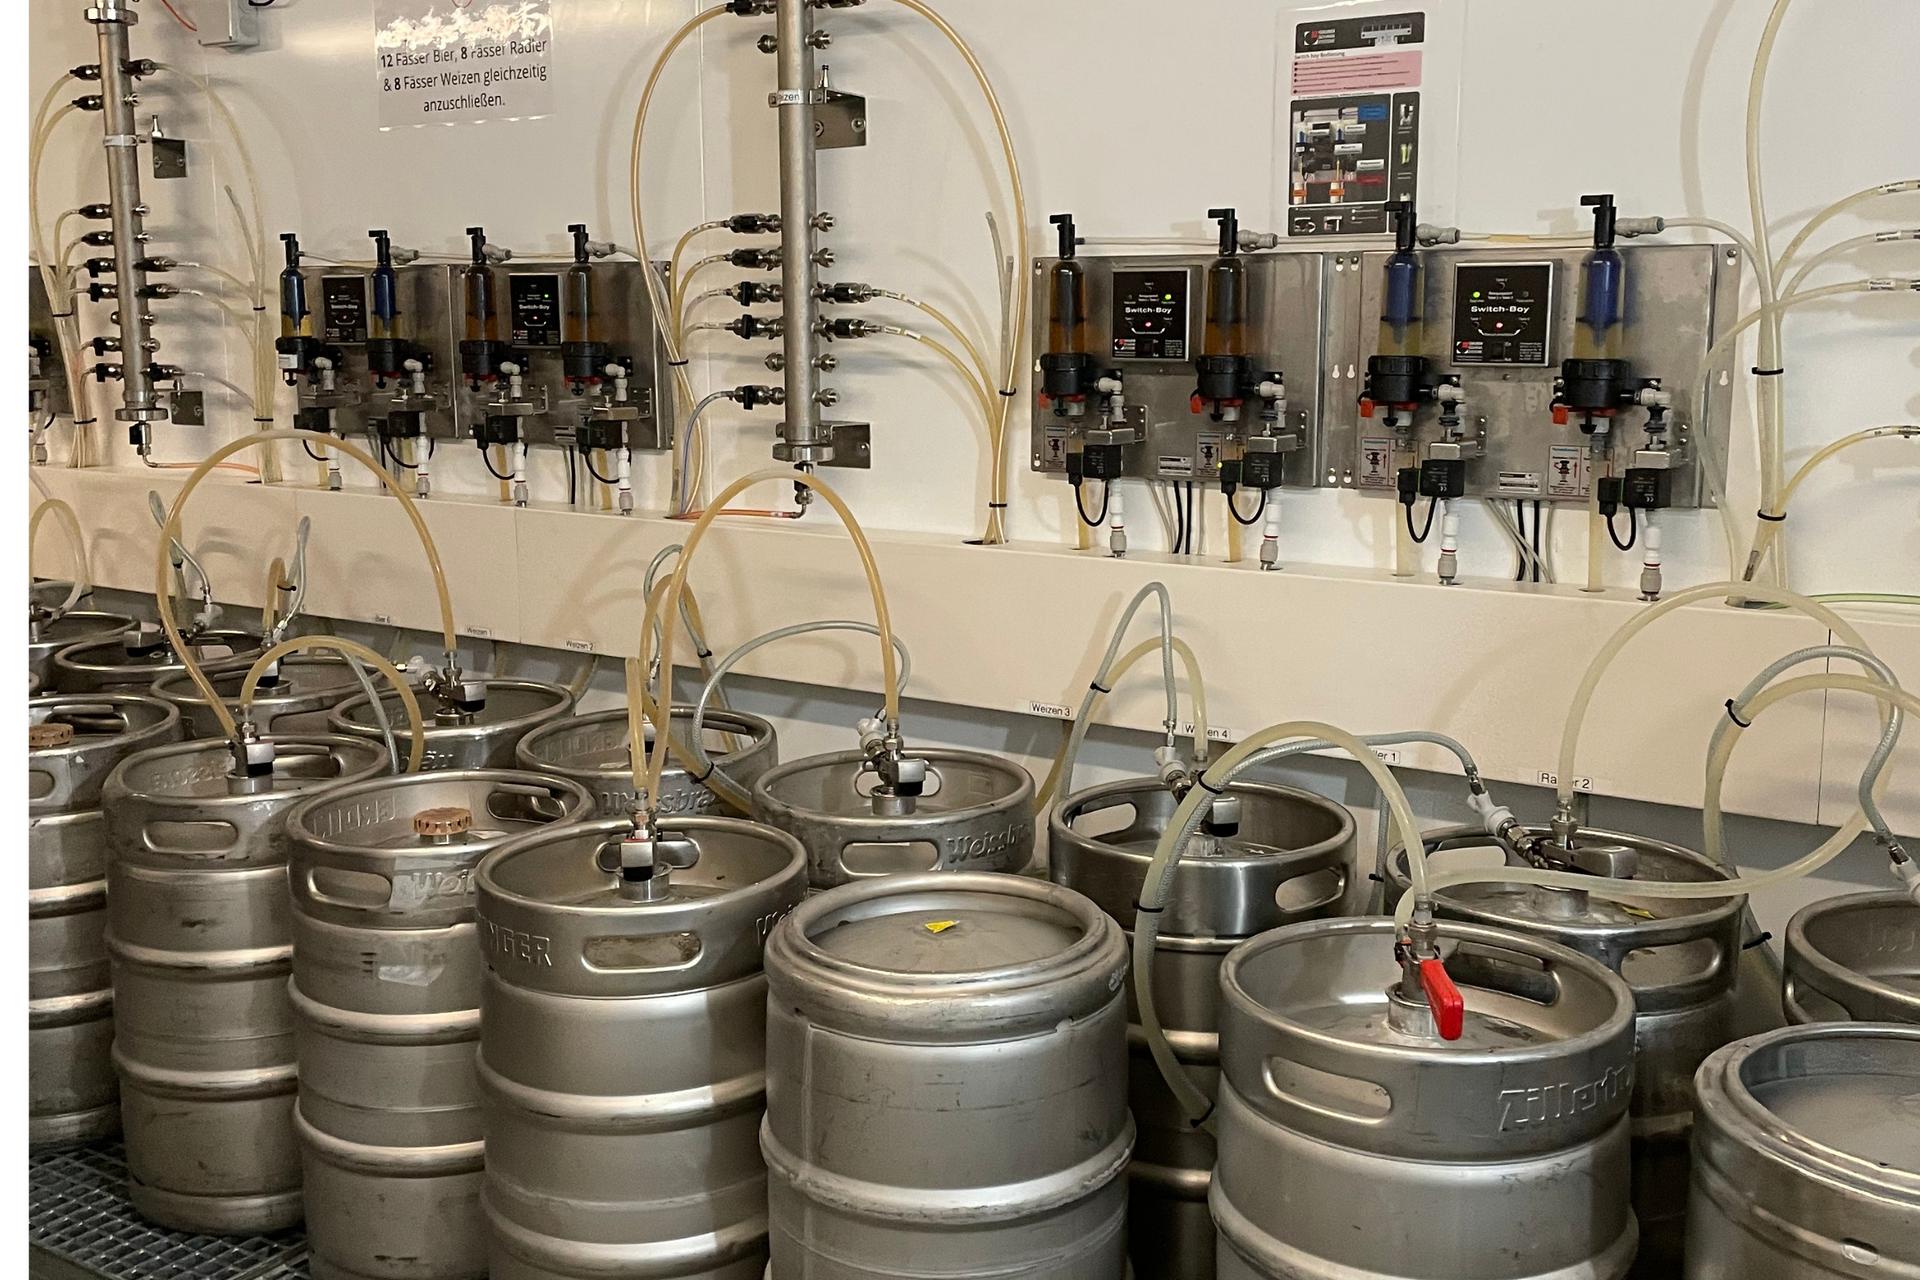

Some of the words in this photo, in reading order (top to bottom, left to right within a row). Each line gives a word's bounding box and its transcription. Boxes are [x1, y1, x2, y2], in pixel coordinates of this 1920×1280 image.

[381, 54, 393, 67] 12
[433, 49, 457, 63] Bier,
[461, 46, 467, 59] 8
[384, 78, 392, 91] &
[395, 77, 401, 90] 8
[403, 75, 438, 89] Fässer
[440, 70, 480, 86] Weizen
[484, 63, 546, 86] gleichzeitig
[423, 92, 505, 112] anzuschließen.
[1032, 702, 1062, 715] Weizen
[1065, 708, 1070, 716] 3
[1222, 729, 1228, 738] 4
[1582, 778, 1590, 789] 2
